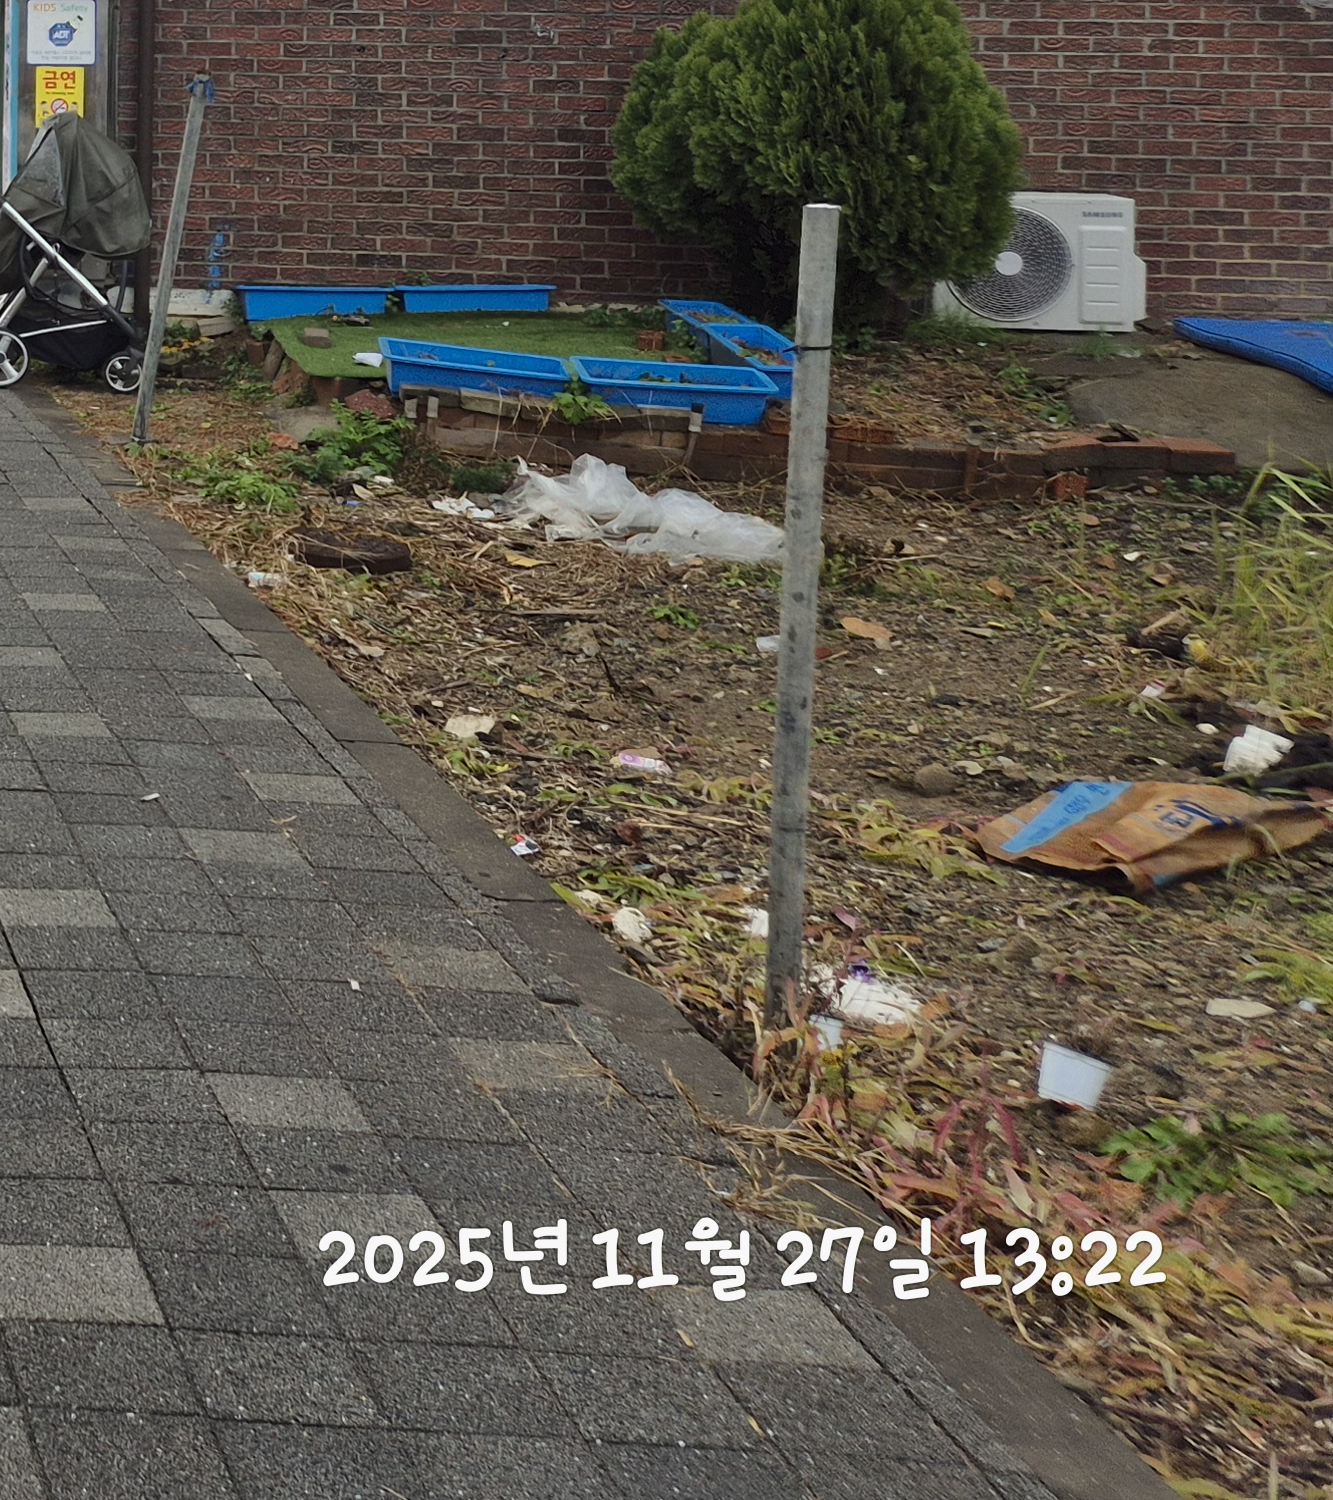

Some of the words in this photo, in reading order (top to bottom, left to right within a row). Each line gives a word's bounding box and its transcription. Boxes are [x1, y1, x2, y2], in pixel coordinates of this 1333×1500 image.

[33, 3, 57, 12] KIDS
[60, 3, 89, 13] Safety
[53, 30, 71, 39] ADT
[42, 70, 76, 90] 금연
